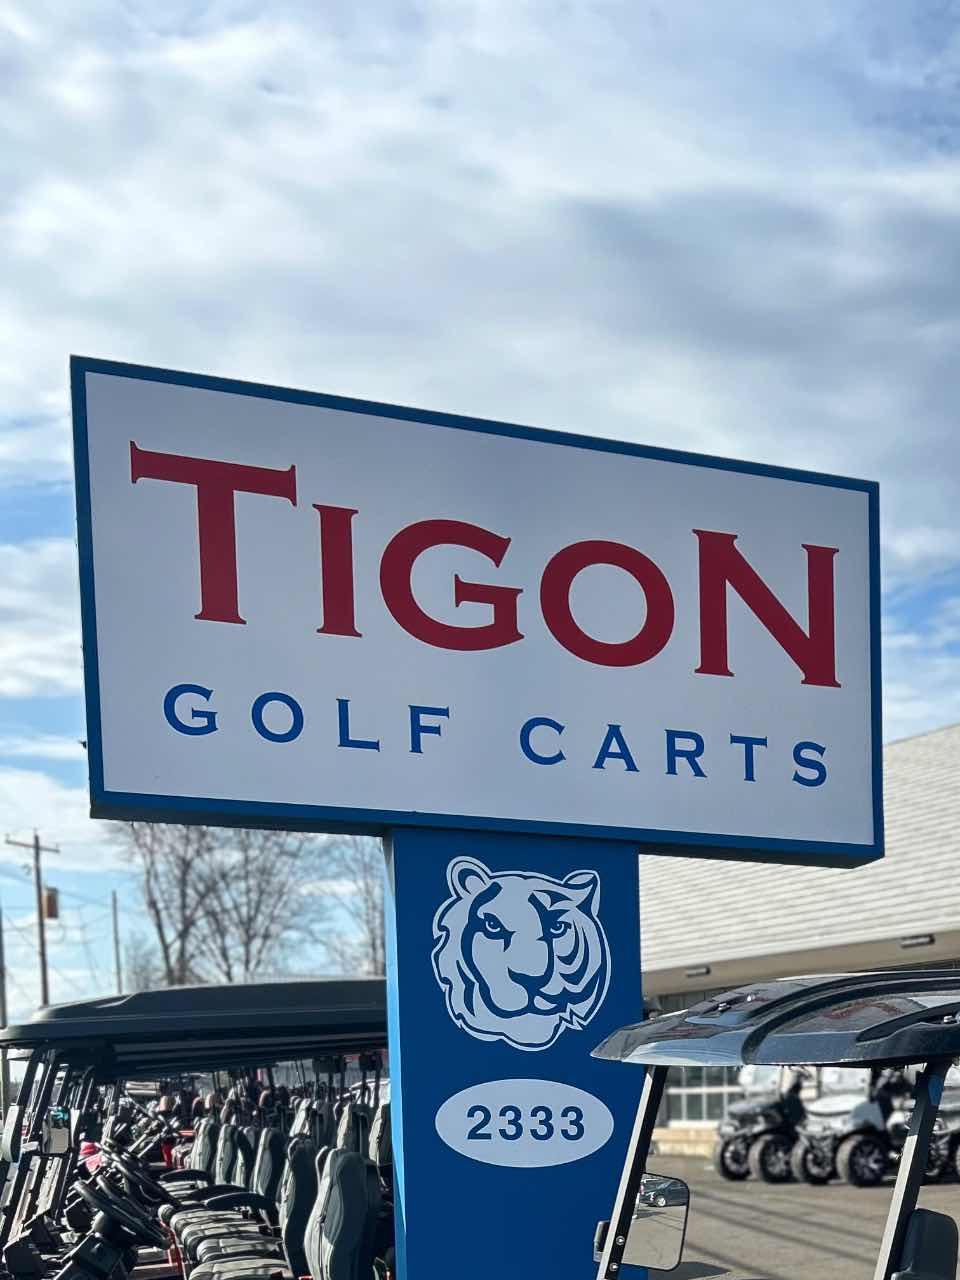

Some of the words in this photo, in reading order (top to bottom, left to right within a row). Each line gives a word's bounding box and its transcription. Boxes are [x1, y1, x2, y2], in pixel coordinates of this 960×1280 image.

[131, 441, 841, 688] TIGON
[162, 683, 450, 754] GOLF
[519, 716, 828, 789] CARTS
[467, 1105, 585, 1141] 2333
